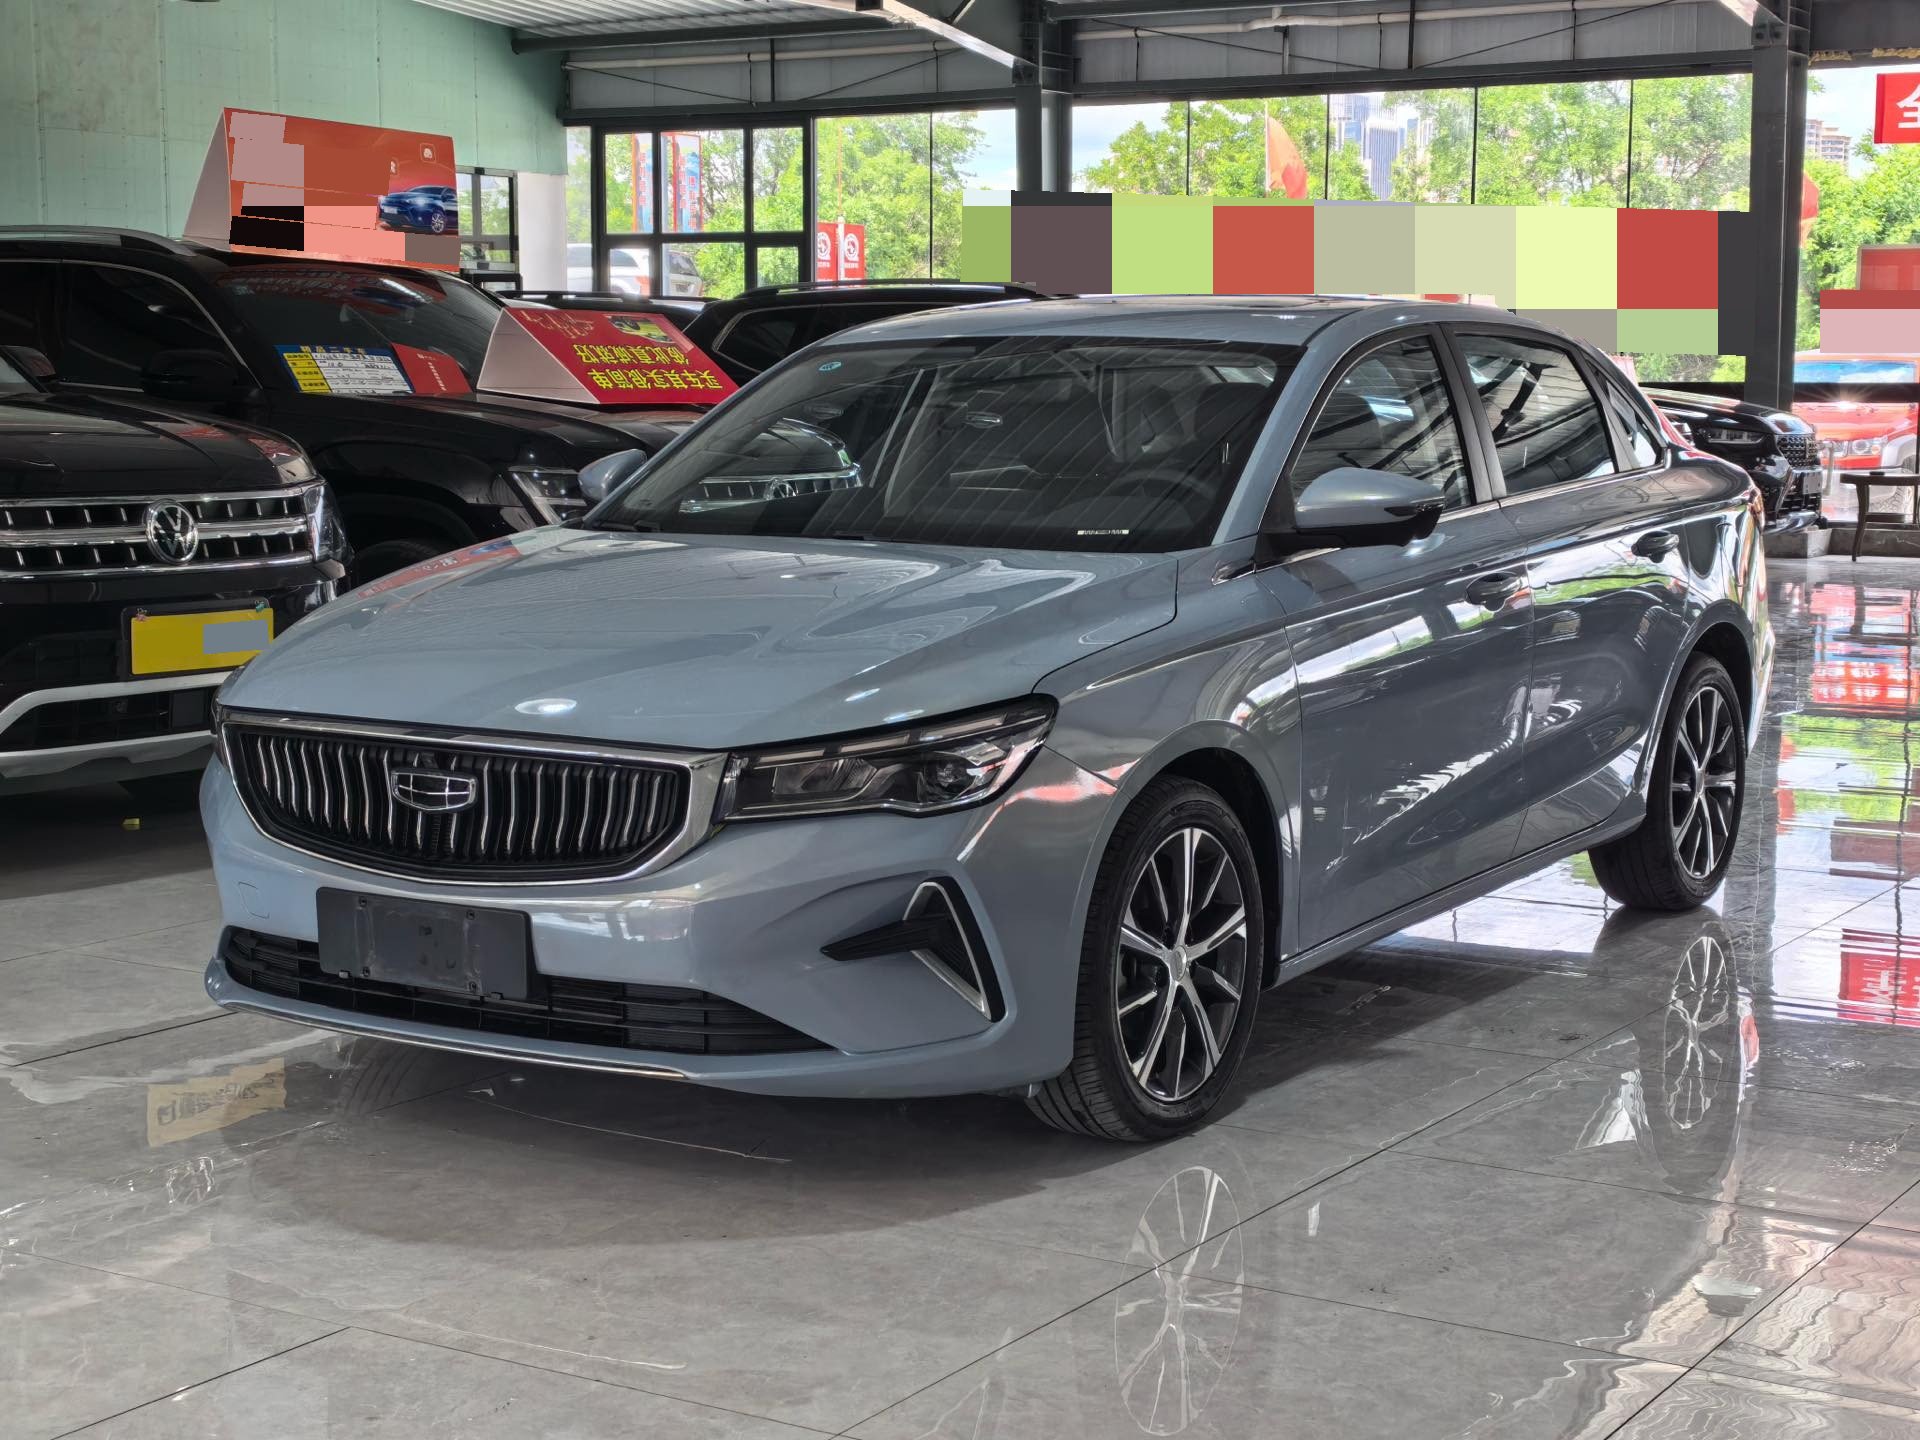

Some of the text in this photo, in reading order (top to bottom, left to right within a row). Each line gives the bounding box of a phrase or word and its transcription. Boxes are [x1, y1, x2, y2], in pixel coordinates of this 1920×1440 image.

[573, 344, 689, 365] 彼此真诚就好
[588, 369, 723, 389] 买车其实很简单
